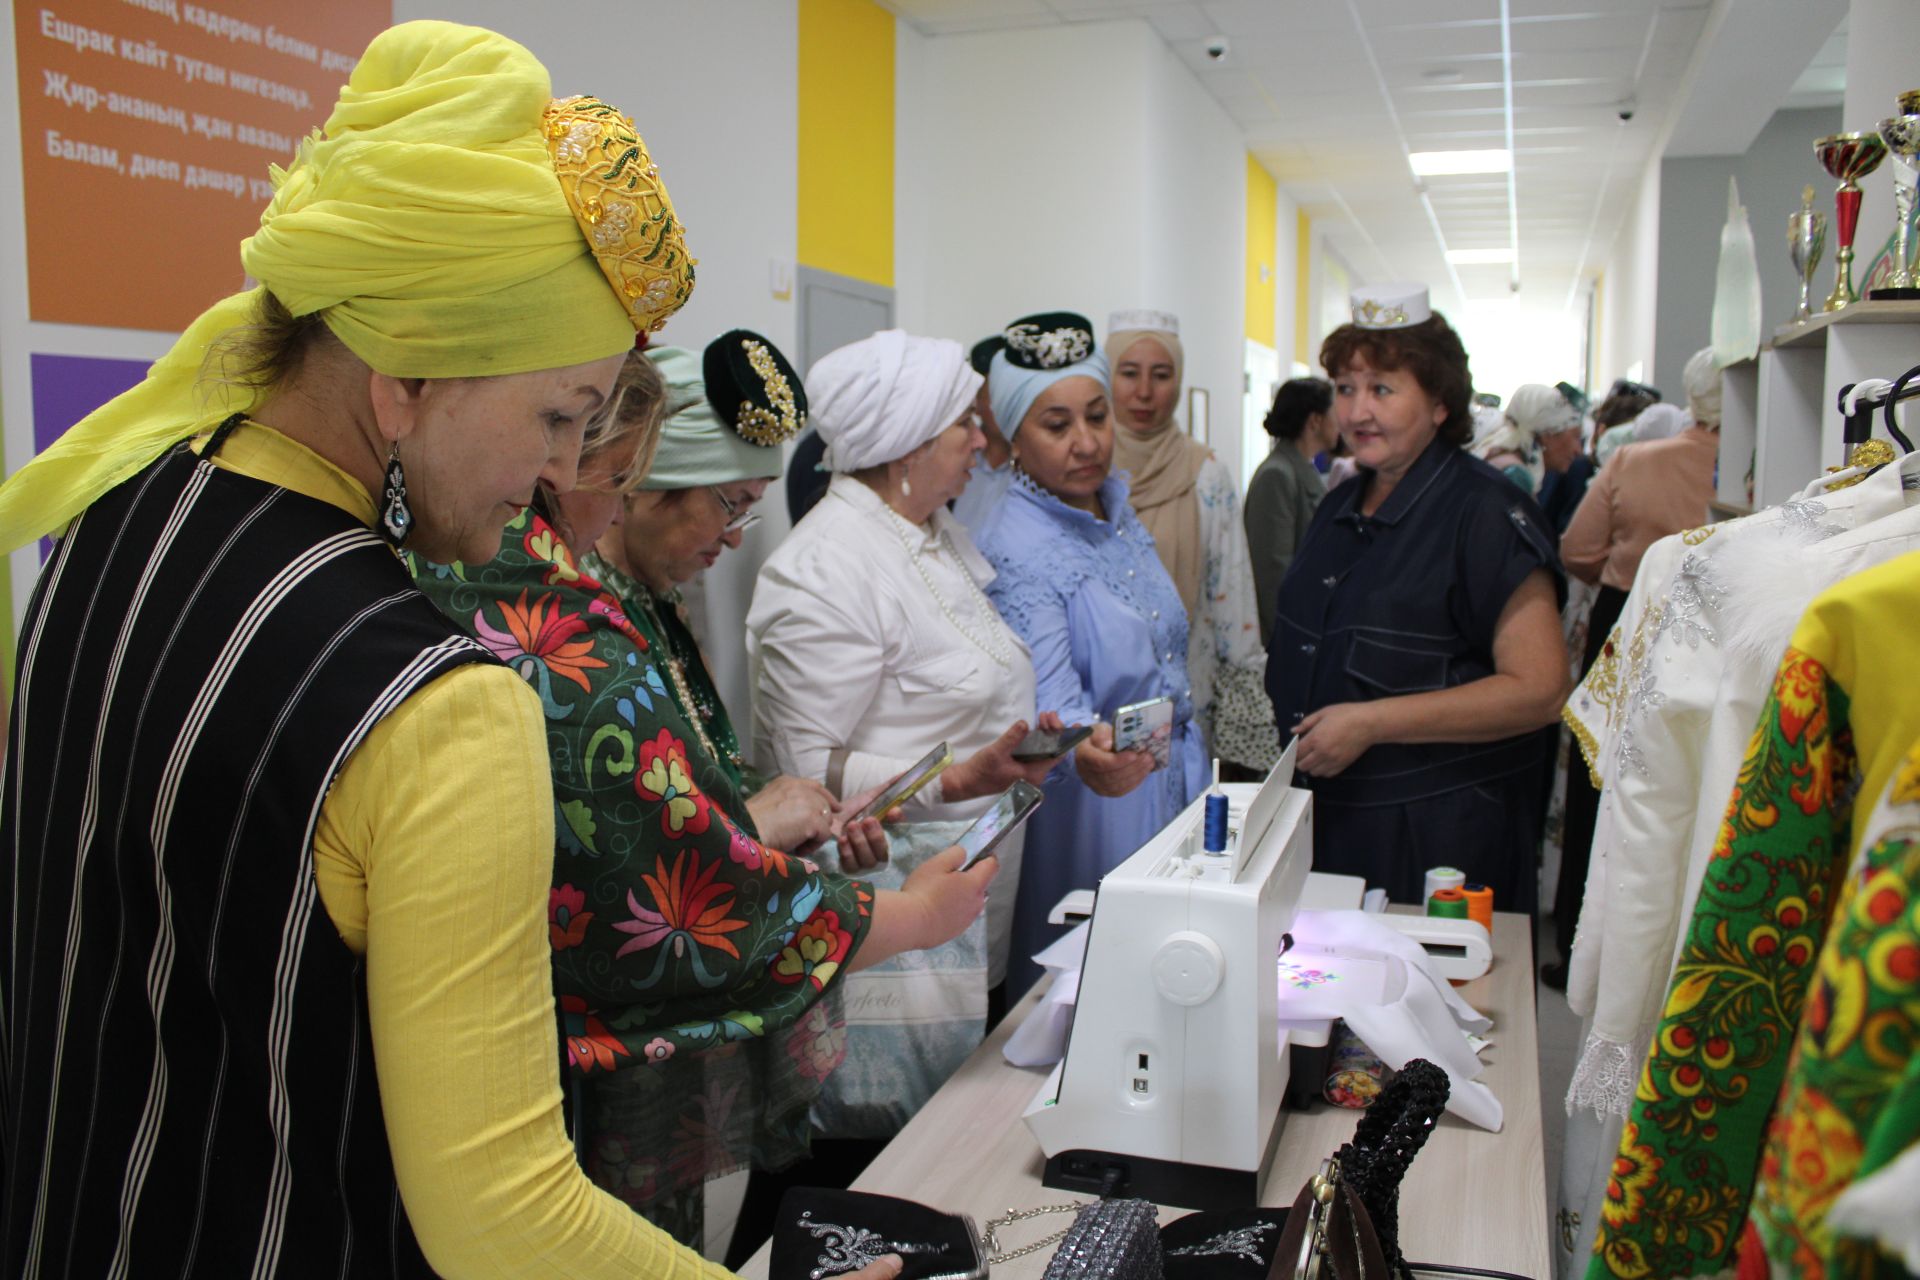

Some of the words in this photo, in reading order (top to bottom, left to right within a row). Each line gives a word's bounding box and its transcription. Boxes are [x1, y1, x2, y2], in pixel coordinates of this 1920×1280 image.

[40, 9, 115, 55] Ешрак
[120, 39, 169, 70] кайт
[173, 53, 226, 84] туган
[43, 68, 189, 135] Җир-ананың
[236, 123, 292, 154] авазы
[46, 129, 125, 176] Балам,
[129, 152, 181, 183] диеп
